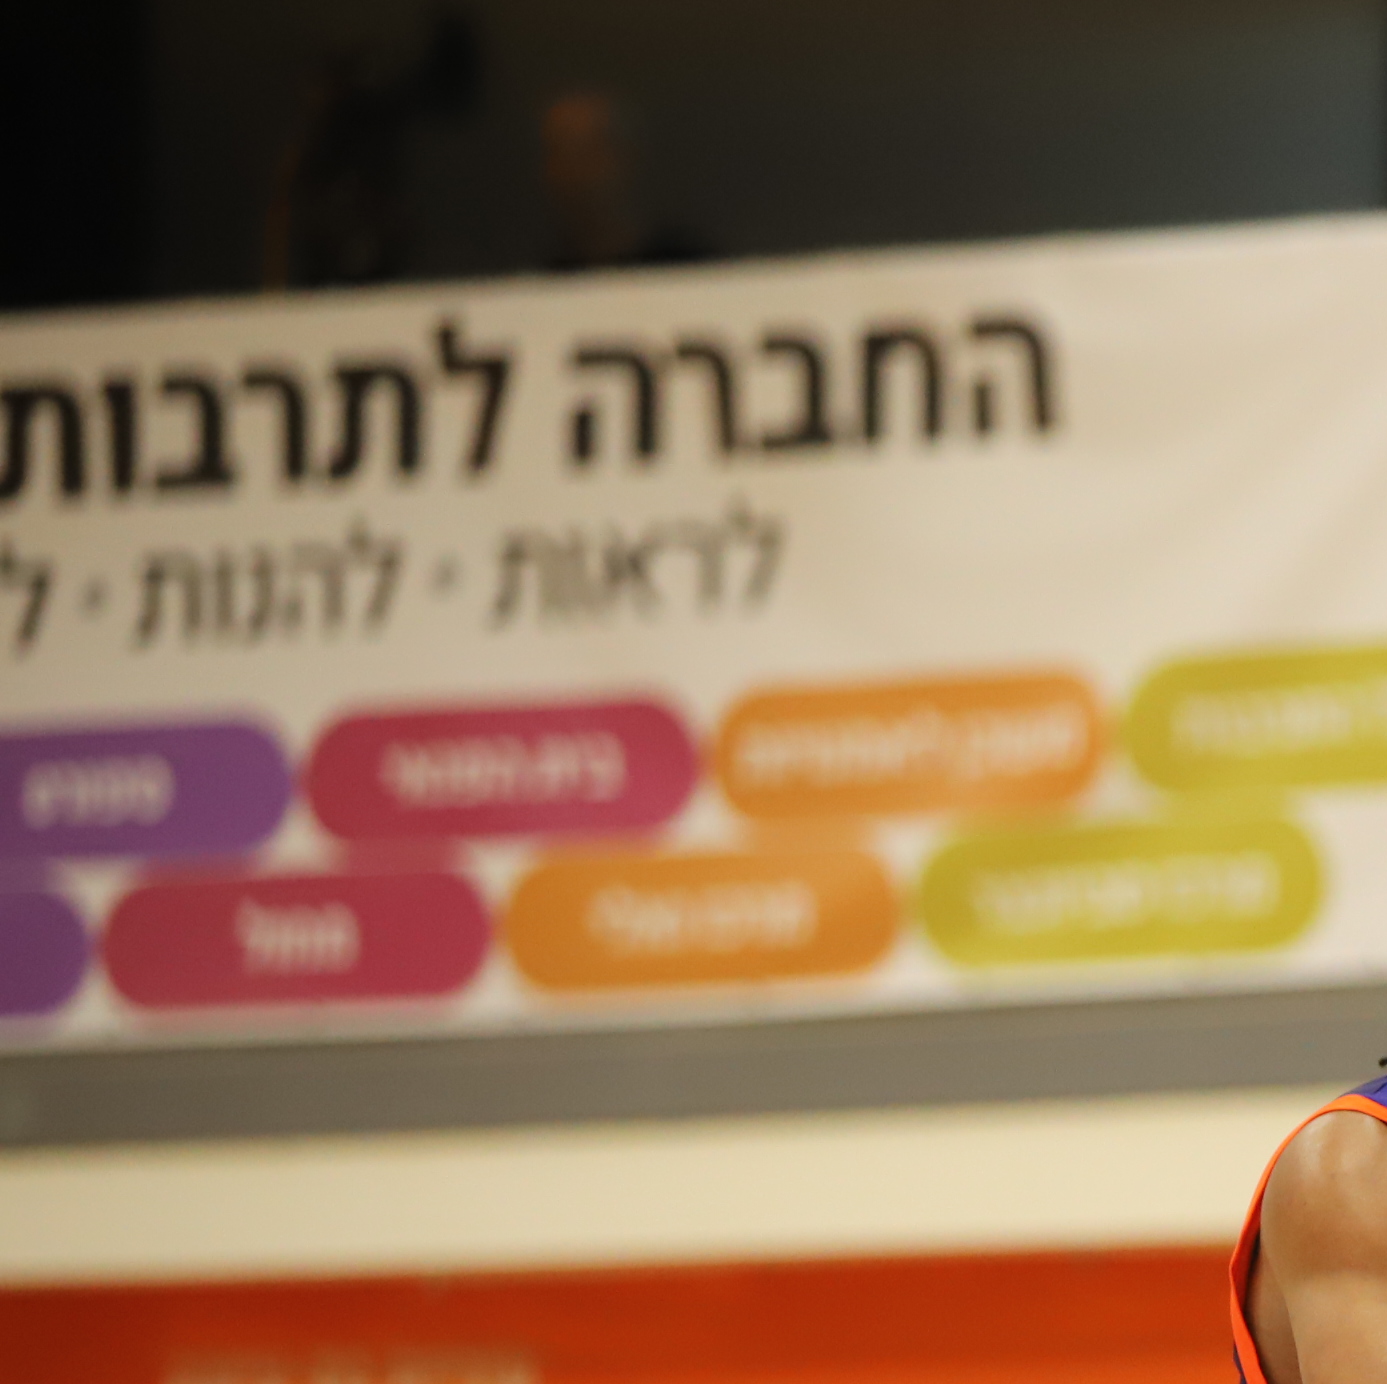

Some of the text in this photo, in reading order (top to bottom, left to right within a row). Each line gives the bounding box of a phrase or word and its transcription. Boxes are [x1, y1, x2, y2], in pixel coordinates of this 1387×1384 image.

[0, 310, 1058, 502] החברה לתרבות
[136, 522, 401, 650] להנות
[492, 498, 782, 630] לראות
